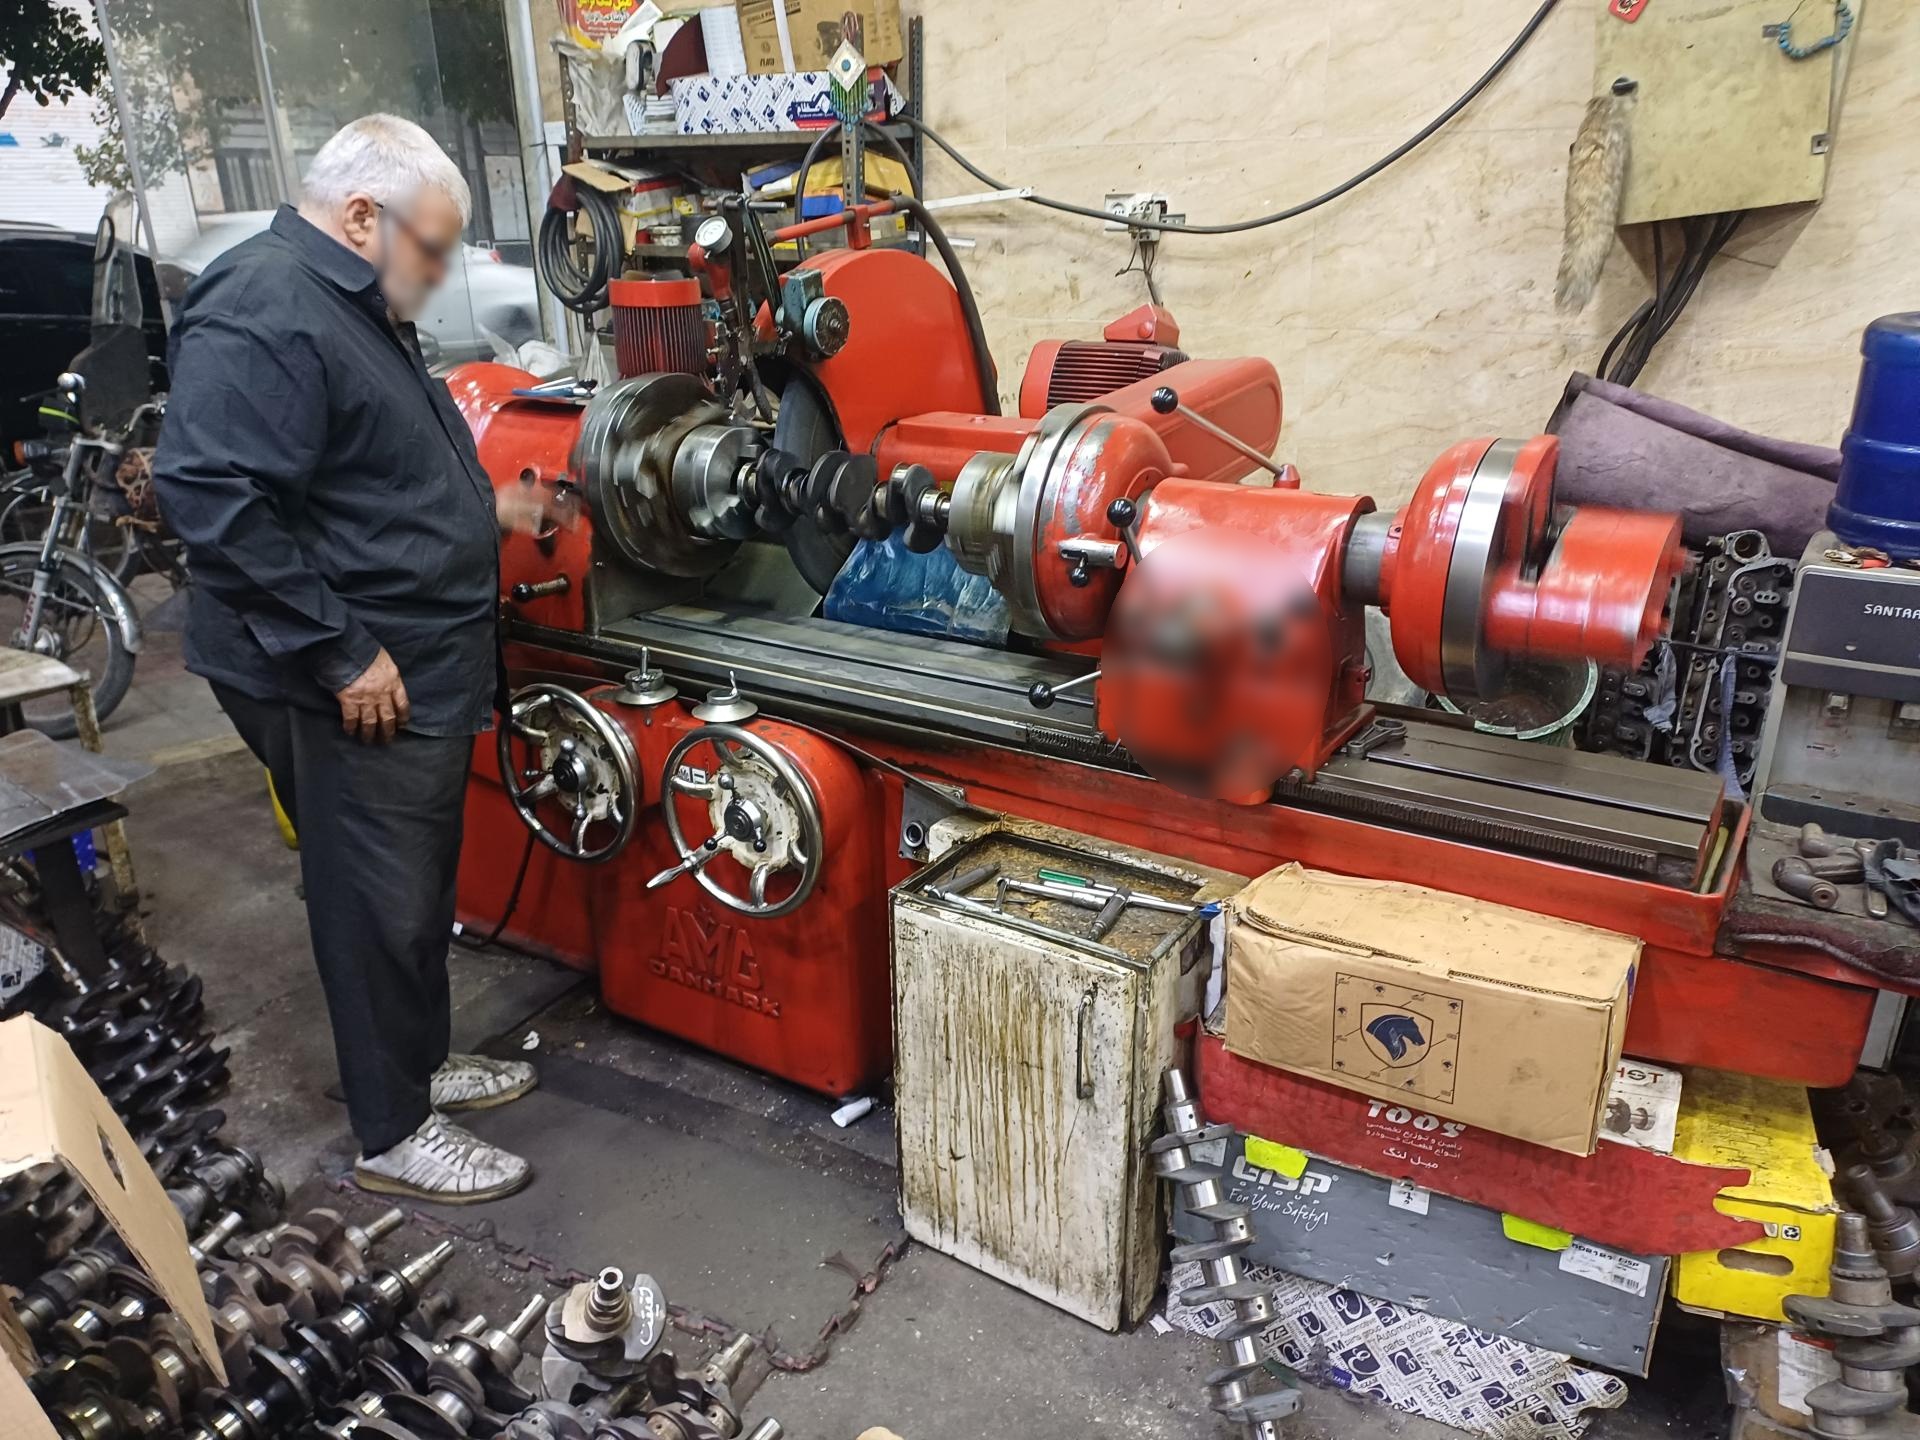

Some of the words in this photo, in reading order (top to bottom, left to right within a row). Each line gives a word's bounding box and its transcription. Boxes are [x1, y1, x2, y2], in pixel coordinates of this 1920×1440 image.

[650, 960, 781, 1017] DANMARK
[1367, 1099, 1468, 1139] TOOS
[1382, 1145, 1407, 1160] لنگ
[1409, 1154, 1440, 1171] میل
[1229, 1187, 1250, 1204] For
[1249, 1192, 1282, 1217] Your
[1280, 1201, 1330, 1235] Safety!
[1375, 1311, 1428, 1346] Automotive
[1382, 1336, 1408, 1356] parts
[1405, 1322, 1435, 1345] group
[1441, 1328, 1482, 1386] EZAM
[1535, 1360, 1561, 1379] parts
[1505, 1371, 1536, 1393] group
[1514, 1368, 1567, 1403] Automotive
[1494, 1390, 1541, 1422] EZAM
